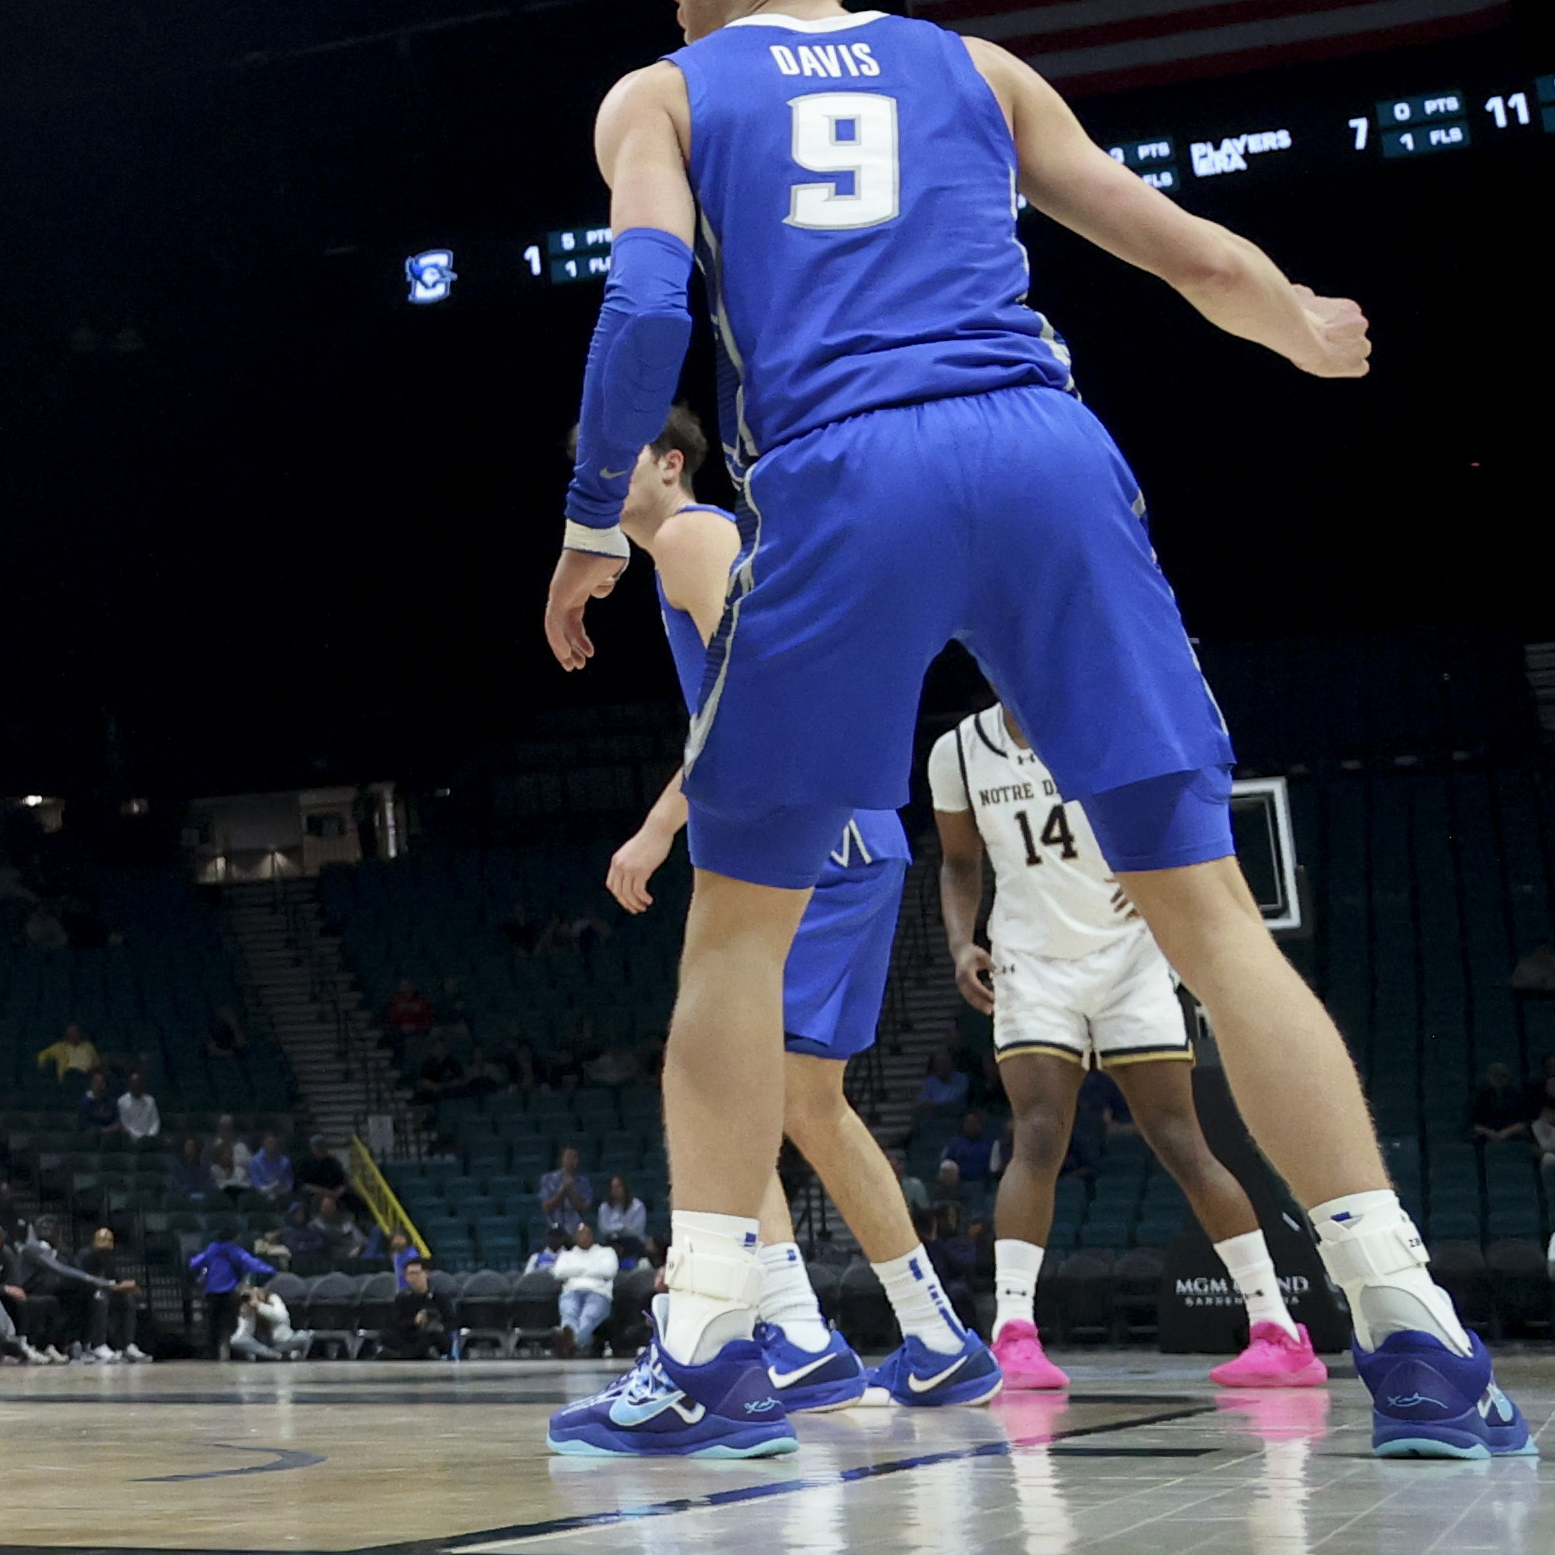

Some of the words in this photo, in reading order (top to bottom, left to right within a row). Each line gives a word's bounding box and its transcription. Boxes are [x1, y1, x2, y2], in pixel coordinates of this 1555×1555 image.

[769, 42, 881, 78] DAVIS
[1348, 117, 1369, 150] 7
[1484, 92, 1530, 128] 11
[1393, 102, 1411, 121] 0
[1424, 96, 1460, 115] PTS
[1399, 133, 1415, 151] 1
[781, 91, 901, 231] 9
[523, 245, 541, 277] 1
[564, 259, 578, 278] 1
[979, 782, 1034, 806] NOTRE
[1014, 804, 1079, 867] 14
[1175, 1277, 1228, 1294] MGM
